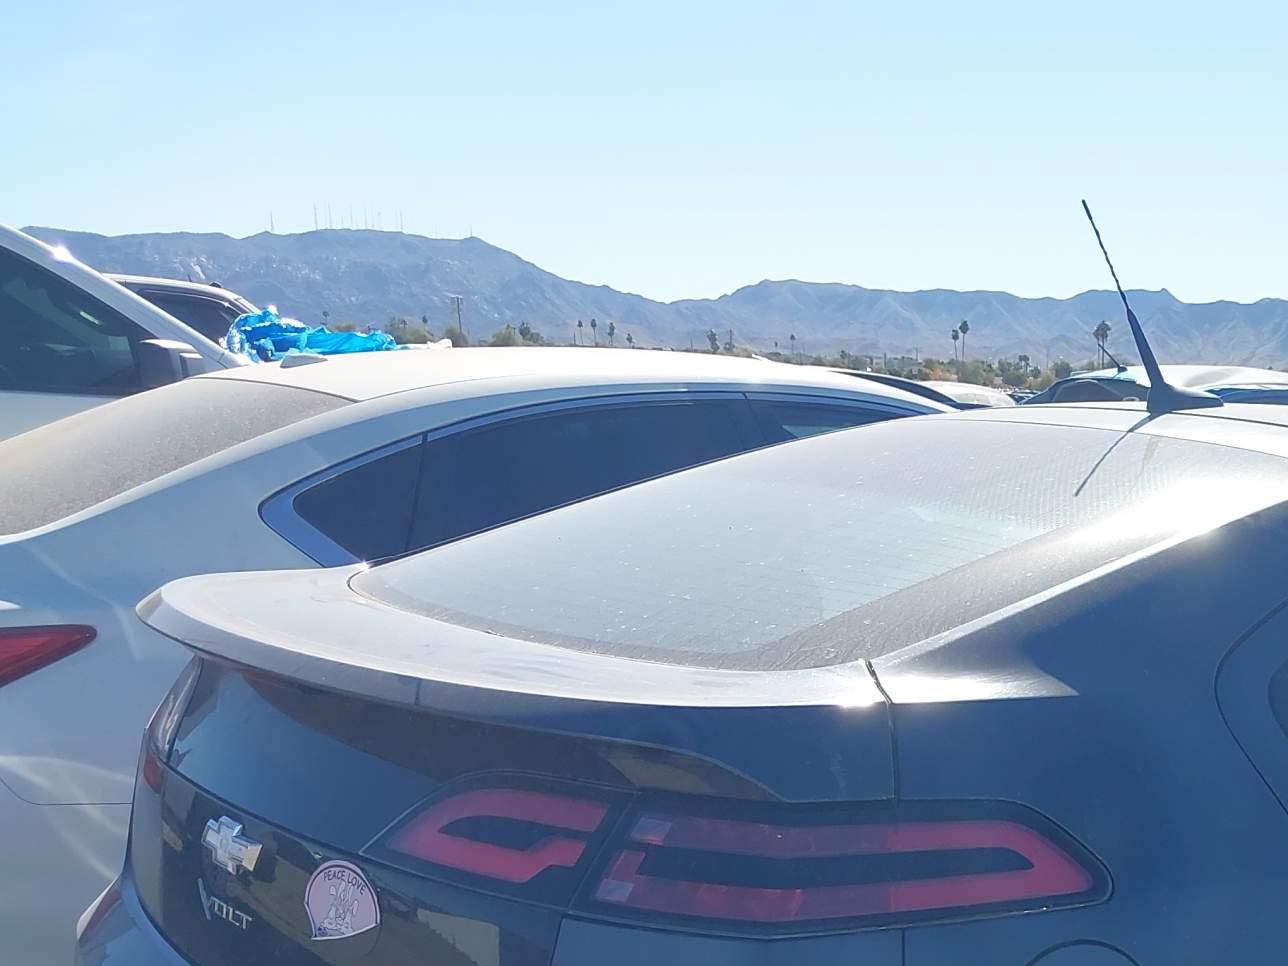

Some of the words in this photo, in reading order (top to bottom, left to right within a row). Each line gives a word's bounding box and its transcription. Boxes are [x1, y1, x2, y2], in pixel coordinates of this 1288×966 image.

[323, 870, 346, 881] PEACE
[347, 872, 367, 896] LOVE
[198, 878, 253, 929] VOLT
